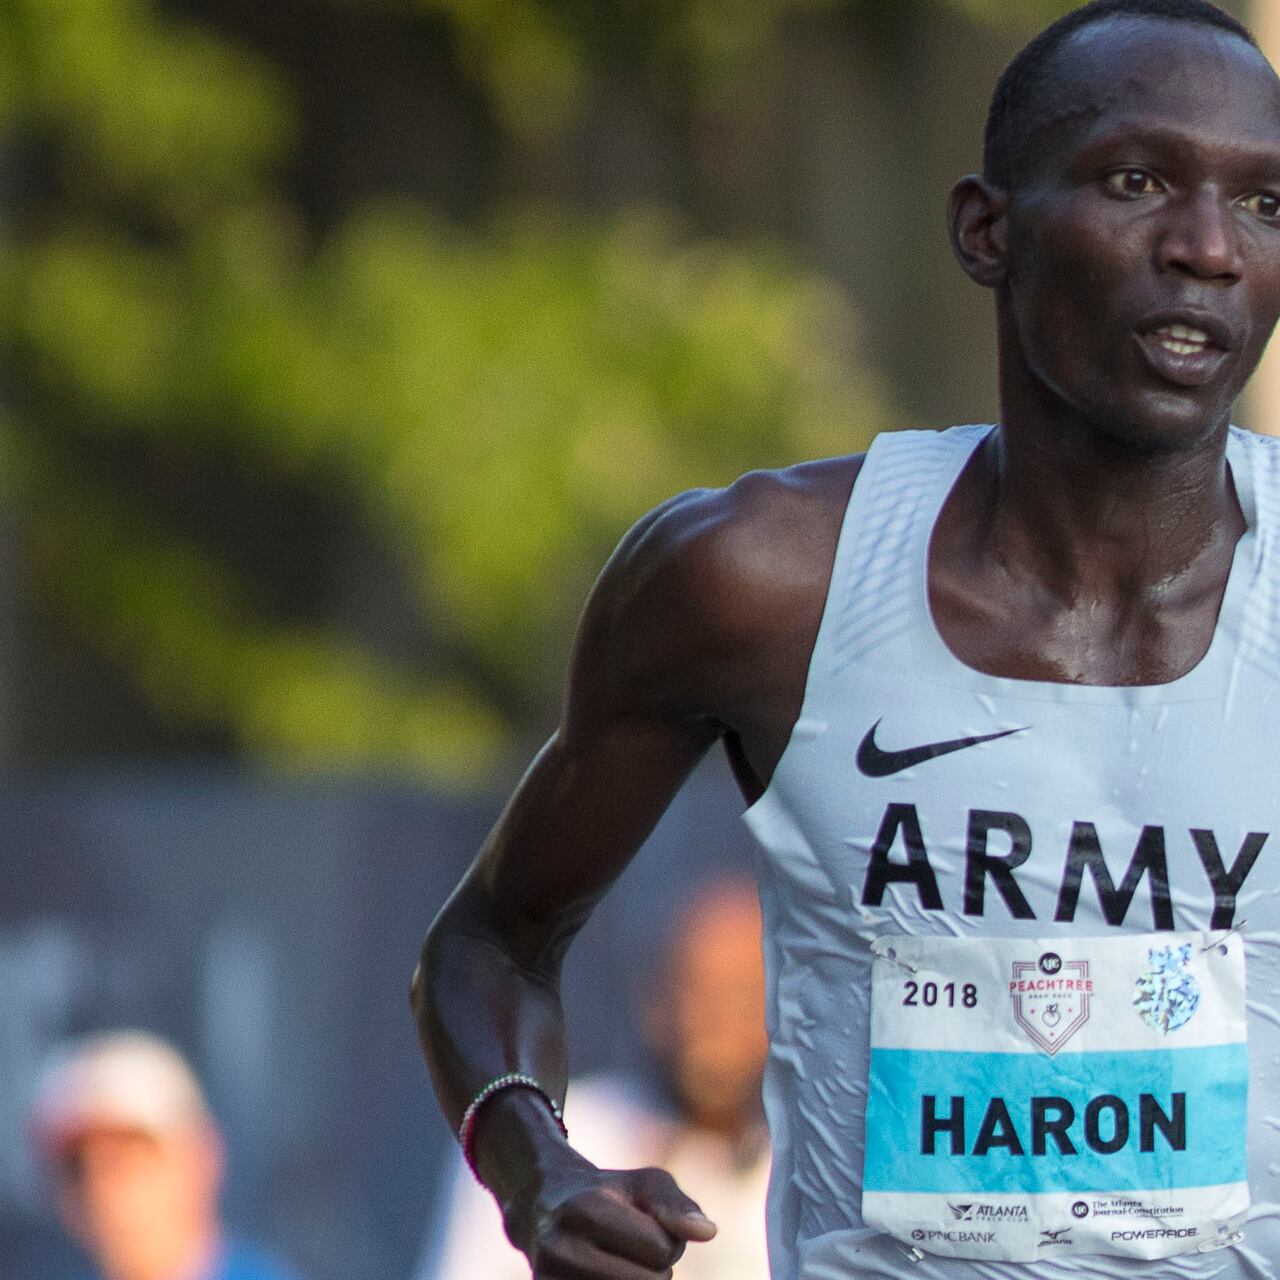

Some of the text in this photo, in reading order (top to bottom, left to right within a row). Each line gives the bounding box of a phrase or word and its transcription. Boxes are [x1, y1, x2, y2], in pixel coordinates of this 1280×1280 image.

[861, 802, 1270, 931] ARMY
[902, 980, 978, 1009] 2018
[1009, 979, 1093, 993] PEACHTREE
[921, 1091, 1187, 1157] HARON
[976, 1205, 1028, 1217] ATLANTA
[1111, 1228, 1198, 1241] POWERADE
